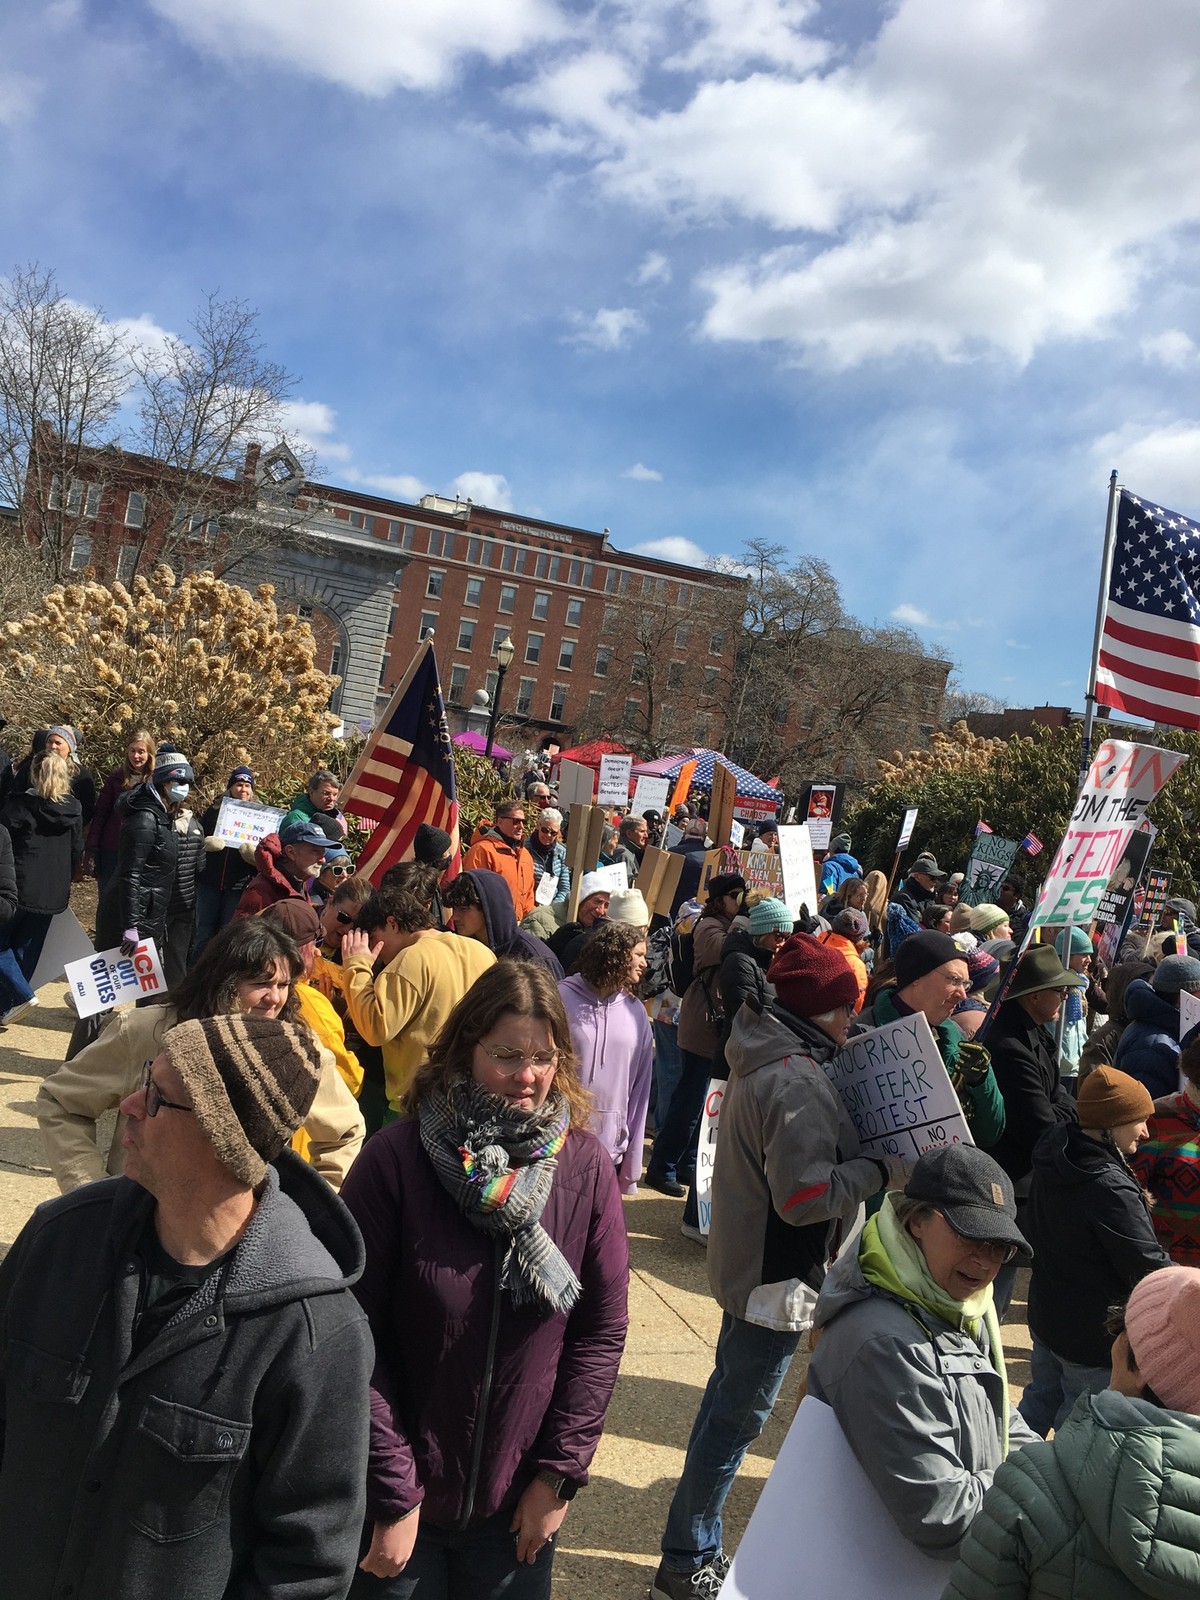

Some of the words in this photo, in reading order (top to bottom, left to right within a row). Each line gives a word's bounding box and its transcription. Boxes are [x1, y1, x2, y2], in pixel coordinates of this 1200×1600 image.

[539, 529, 572, 543] HOTEL
[604, 758, 629, 766] Democracy
[740, 809, 768, 820] CHAOS?
[1107, 797, 1151, 822] THE
[233, 820, 265, 833] MEANS
[989, 836, 1007, 849] NO
[977, 843, 1012, 862] KINGS
[749, 869, 770, 881] EVEN
[1110, 892, 1128, 905] ONLY
[1098, 901, 1116, 913] KING
[1095, 909, 1117, 923] ERICA
[109, 963, 116, 973] OF
[116, 958, 139, 987] OUT
[133, 945, 160, 992] ICE
[89, 958, 116, 1004] CITIES
[112, 974, 122, 990] OUR
[76, 981, 87, 997] ACLU
[875, 1059, 934, 1102] FEAR
[927, 1125, 946, 1143] NO
[882, 1139, 898, 1155] NO
